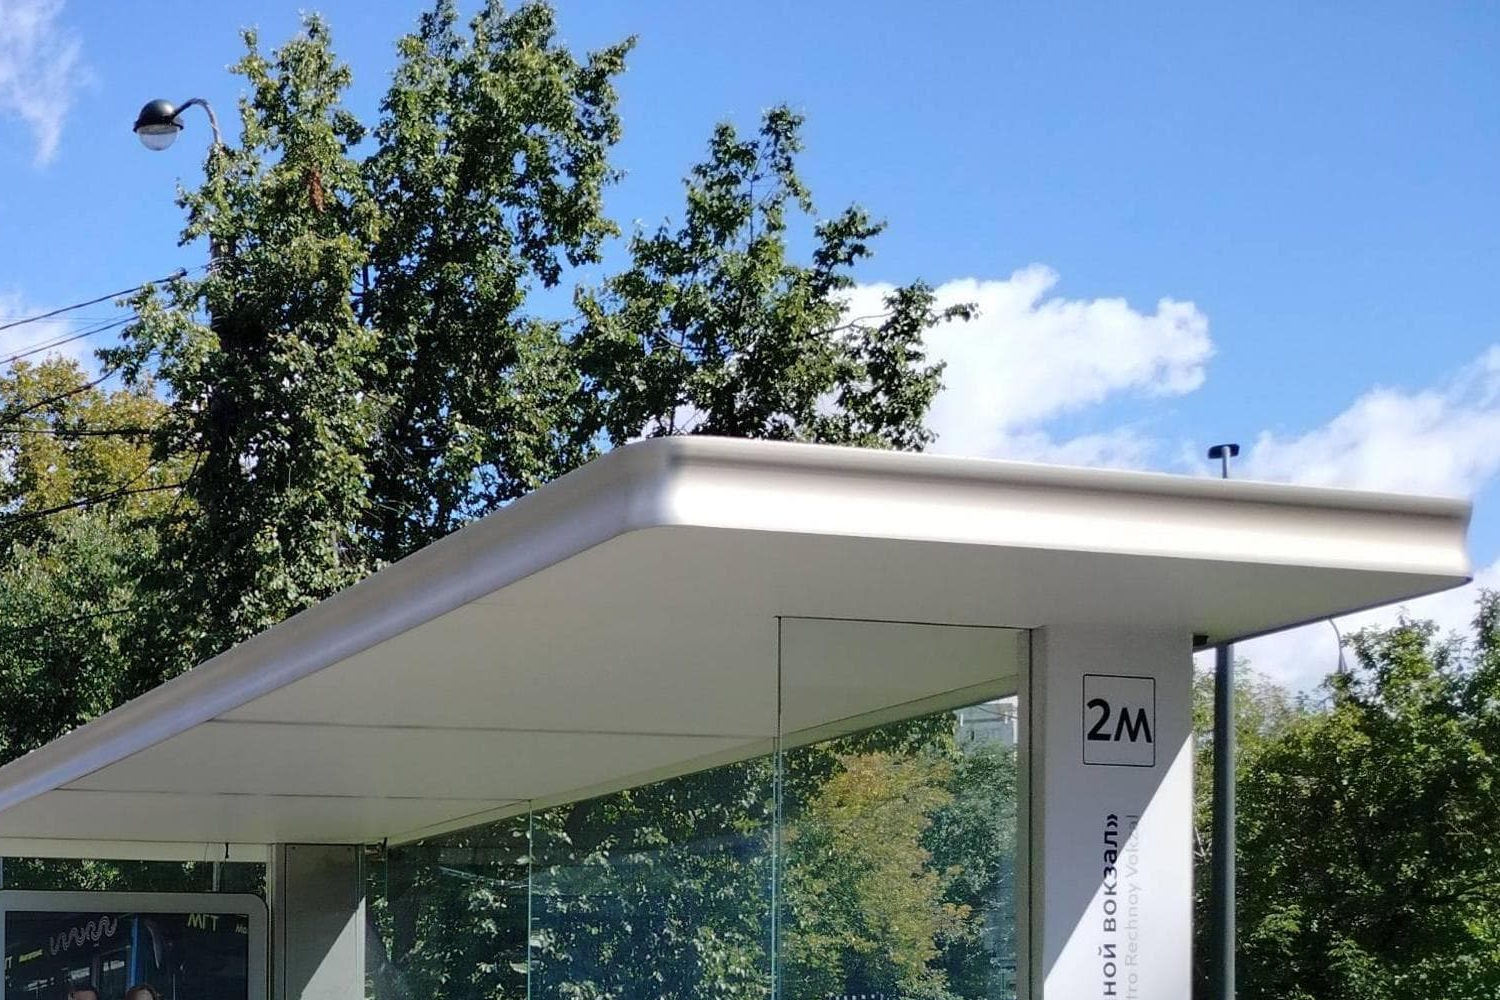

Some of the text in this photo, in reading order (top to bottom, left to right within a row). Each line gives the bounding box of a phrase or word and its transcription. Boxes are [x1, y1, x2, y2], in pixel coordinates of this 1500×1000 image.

[1103, 813, 1119, 933] вокзал»
[1124, 814, 1140, 877] Vokzal
[1124, 883, 1141, 967] Rechnoy
